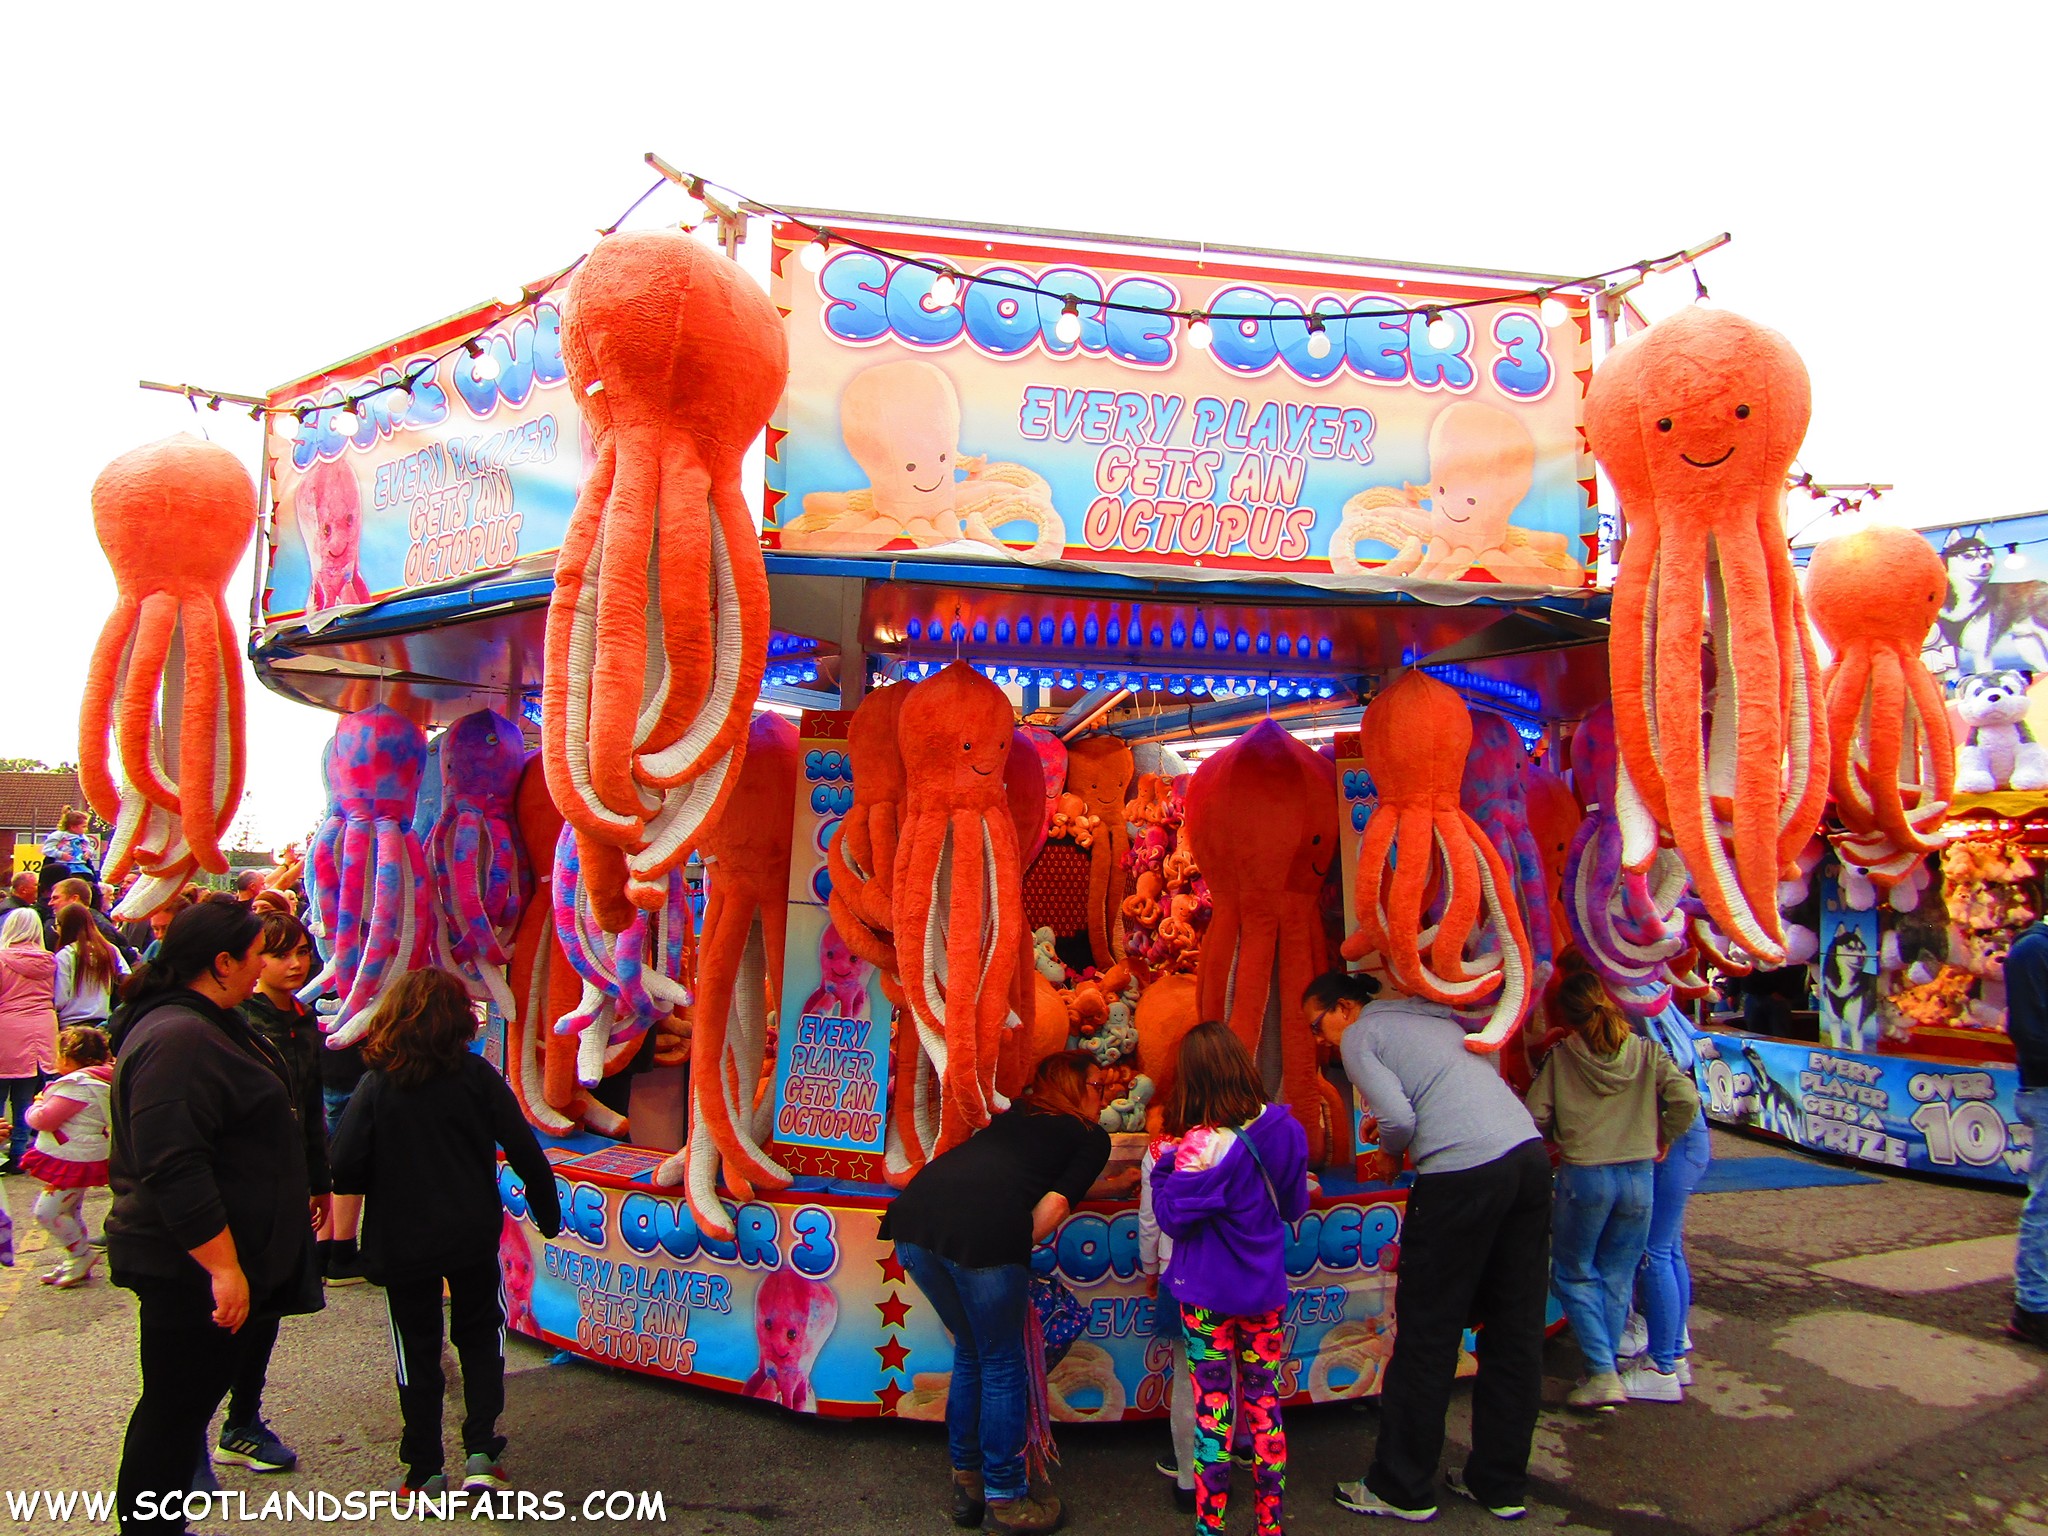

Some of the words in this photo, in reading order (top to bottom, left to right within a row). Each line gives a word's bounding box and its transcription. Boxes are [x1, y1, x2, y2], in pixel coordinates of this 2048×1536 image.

[816, 249, 1180, 370] SCORE
[1206, 283, 1478, 393] OVER
[1490, 305, 1556, 401] 3
[453, 299, 566, 418] OVE
[1019, 385, 1180, 446] EVERY
[1189, 395, 1376, 463] PLAYER
[374, 441, 446, 509] EVERY
[447, 412, 558, 482] PLAYER
[1093, 445, 1219, 501] GETS
[1228, 448, 1307, 506] AN
[409, 481, 472, 541] GETS
[474, 468, 514, 522] AN
[1082, 499, 1317, 561] OCTOPUS
[404, 512, 523, 587] OCTOPUS
[791, 1043, 874, 1081] PLAYER
[799, 1014, 872, 1049] EVERY
[783, 1074, 839, 1106] GETS
[841, 1082, 876, 1112] AN
[1800, 1071, 1888, 1111] PLAYER
[1808, 1051, 1884, 1086] EVERY
[1908, 1072, 1997, 1102] OVER
[778, 1107, 881, 1143] OCTOPUS
[1802, 1095, 1861, 1124] GETS
[1858, 1110, 1885, 1131] A
[1805, 1115, 1909, 1169] PRIZE
[1910, 1101, 2006, 1167] 10
[787, 1203, 840, 1281] 3
[1283, 1202, 1401, 1281] VER
[544, 1242, 613, 1291] EVERY
[617, 1261, 732, 1314] PLAYER
[578, 1286, 636, 1331] GETS
[643, 1301, 690, 1338] AN
[1088, 1296, 1159, 1338] EVE
[575, 1317, 698, 1376] OCTOPUS
